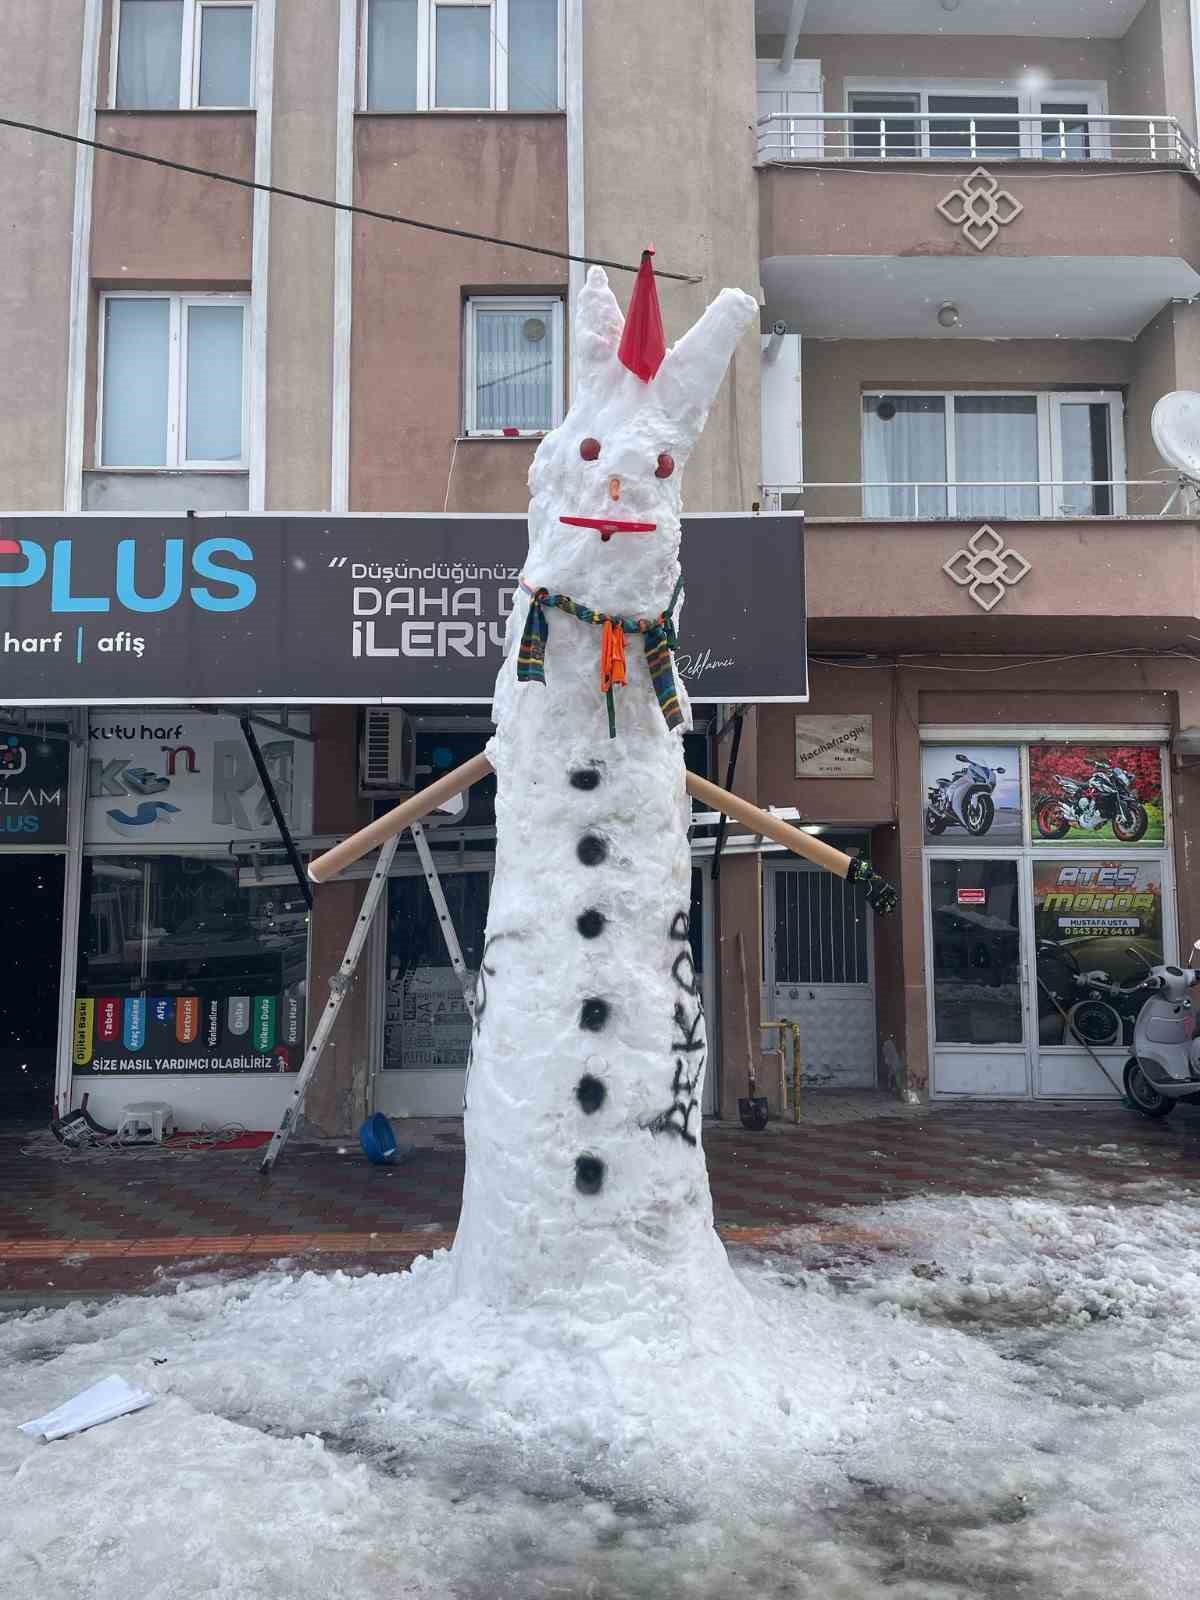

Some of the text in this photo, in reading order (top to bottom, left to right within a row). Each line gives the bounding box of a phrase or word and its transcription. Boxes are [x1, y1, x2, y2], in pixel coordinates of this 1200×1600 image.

[0, 537, 257, 613] PLUS
[353, 587, 481, 616] DAHA
[4, 632, 63, 652] harf
[97, 632, 146, 658] afiş
[88, 725, 184, 740] kutu harf
[0, 787, 61, 806] LAM
[1070, 919, 1129, 927] MUSTAFA USTA
[77, 1002, 88, 1060] Dijital Baskı
[104, 1003, 114, 1036] Tabela
[183, 999, 192, 1041] Kartvizit
[208, 1000, 218, 1047] Yönlendirme
[259, 999, 270, 1049] Yelken Duba
[288, 1021, 297, 1042] Kutu
[92, 1054, 272, 1071] SİZE NASIL YARDIMCI OLABİLİRİZ
